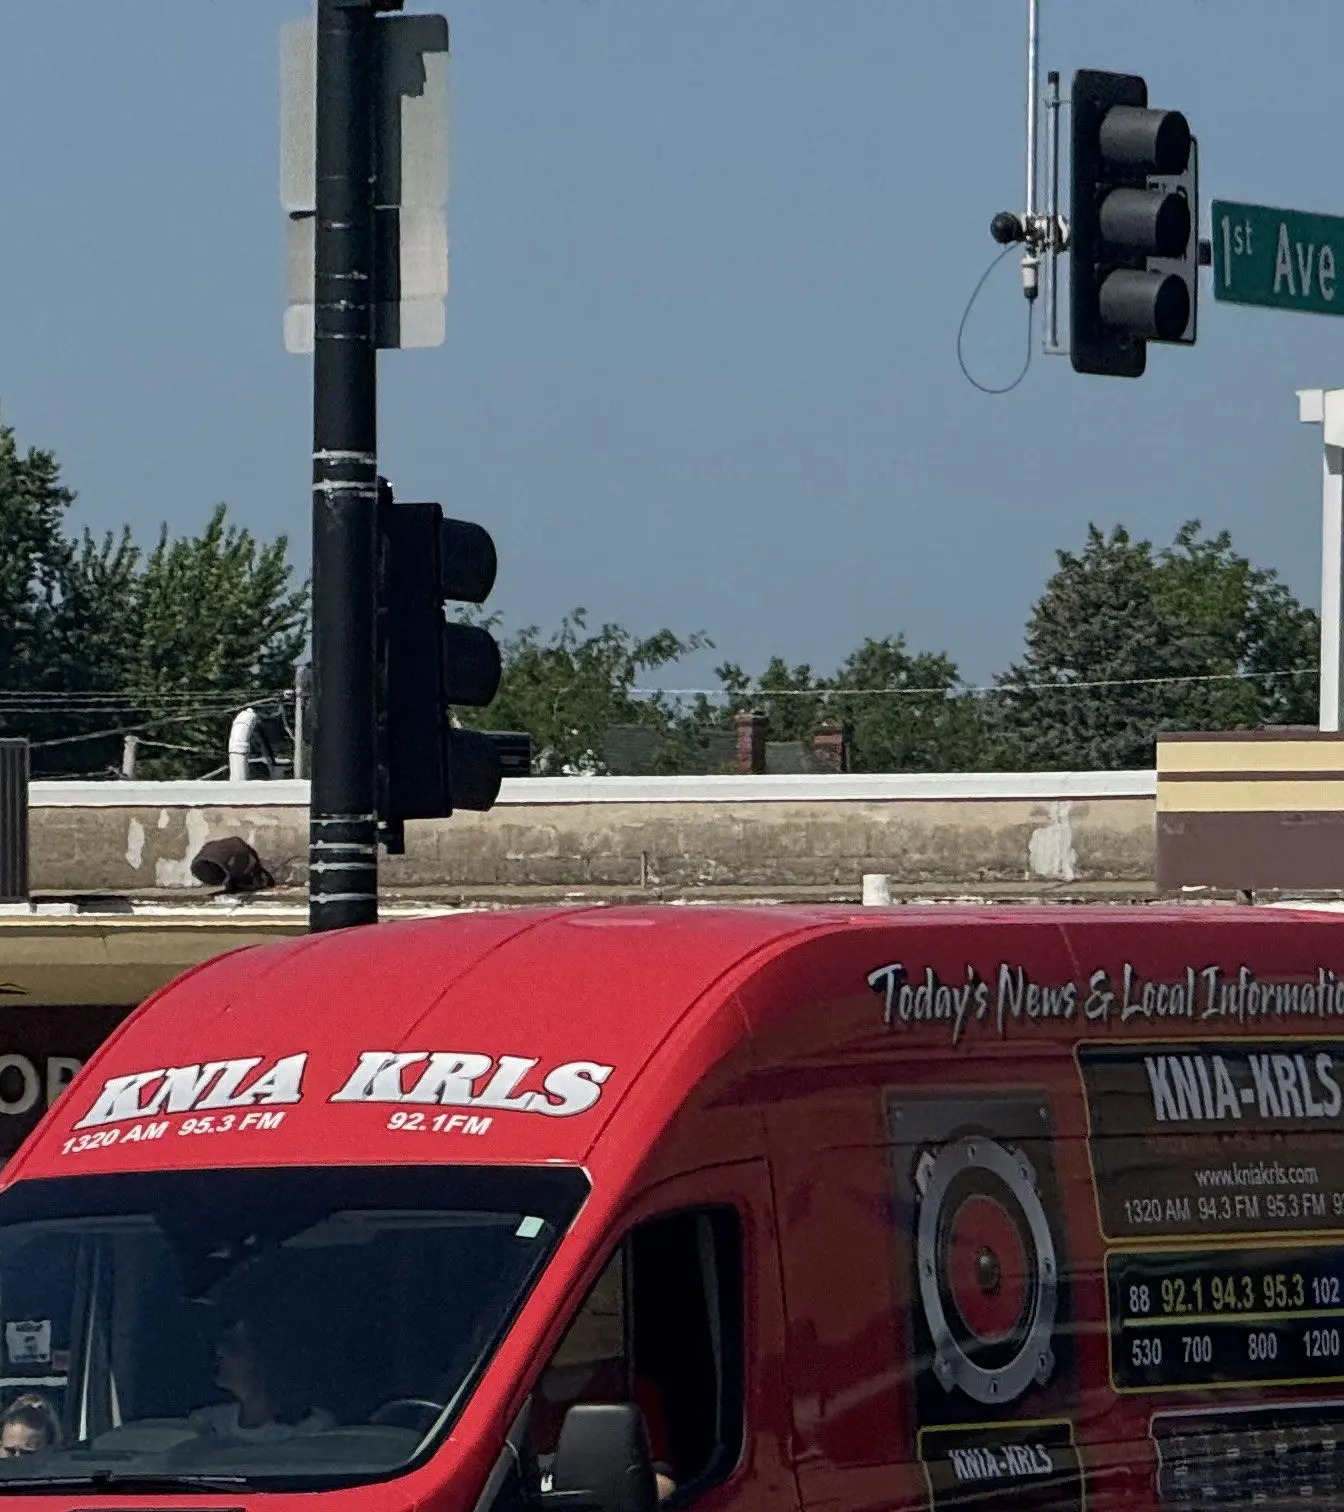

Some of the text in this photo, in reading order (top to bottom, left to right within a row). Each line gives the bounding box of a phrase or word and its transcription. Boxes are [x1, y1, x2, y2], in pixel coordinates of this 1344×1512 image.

[1221, 216, 1253, 287] 1st
[1274, 220, 1336, 300] Ave
[867, 963, 989, 1043] Today's
[996, 963, 1077, 1035] News
[1084, 969, 1112, 1020] &
[1122, 965, 1196, 1021] Local
[72, 1051, 617, 1129] KNIA KRLS
[1146, 1053, 1343, 1121] KNIA-KRLS
[60, 1111, 286, 1156] 1320 AM 95.3 FM
[1195, 1161, 1319, 1186] www.kniakrls.com
[1124, 1199, 1161, 1224] 1320
[1165, 1197, 1192, 1222] AM
[1197, 1196, 1233, 1220] 94.3
[1235, 1195, 1260, 1219] FM
[1266, 1193, 1300, 1218] 95.3
[1302, 1192, 1326, 1217] FM
[1129, 1284, 1150, 1313] 88
[1161, 1276, 1203, 1313] 92.1
[1211, 1275, 1255, 1310] 94.3
[1263, 1273, 1305, 1306] 95.3
[1311, 1276, 1340, 1305] 102
[1131, 1337, 1162, 1365] 530
[1182, 1335, 1213, 1363] 700
[1248, 1333, 1278, 1361] 800
[1302, 1329, 1340, 1358] 1200
[948, 1444, 1054, 1481] KNIA-KRLS
